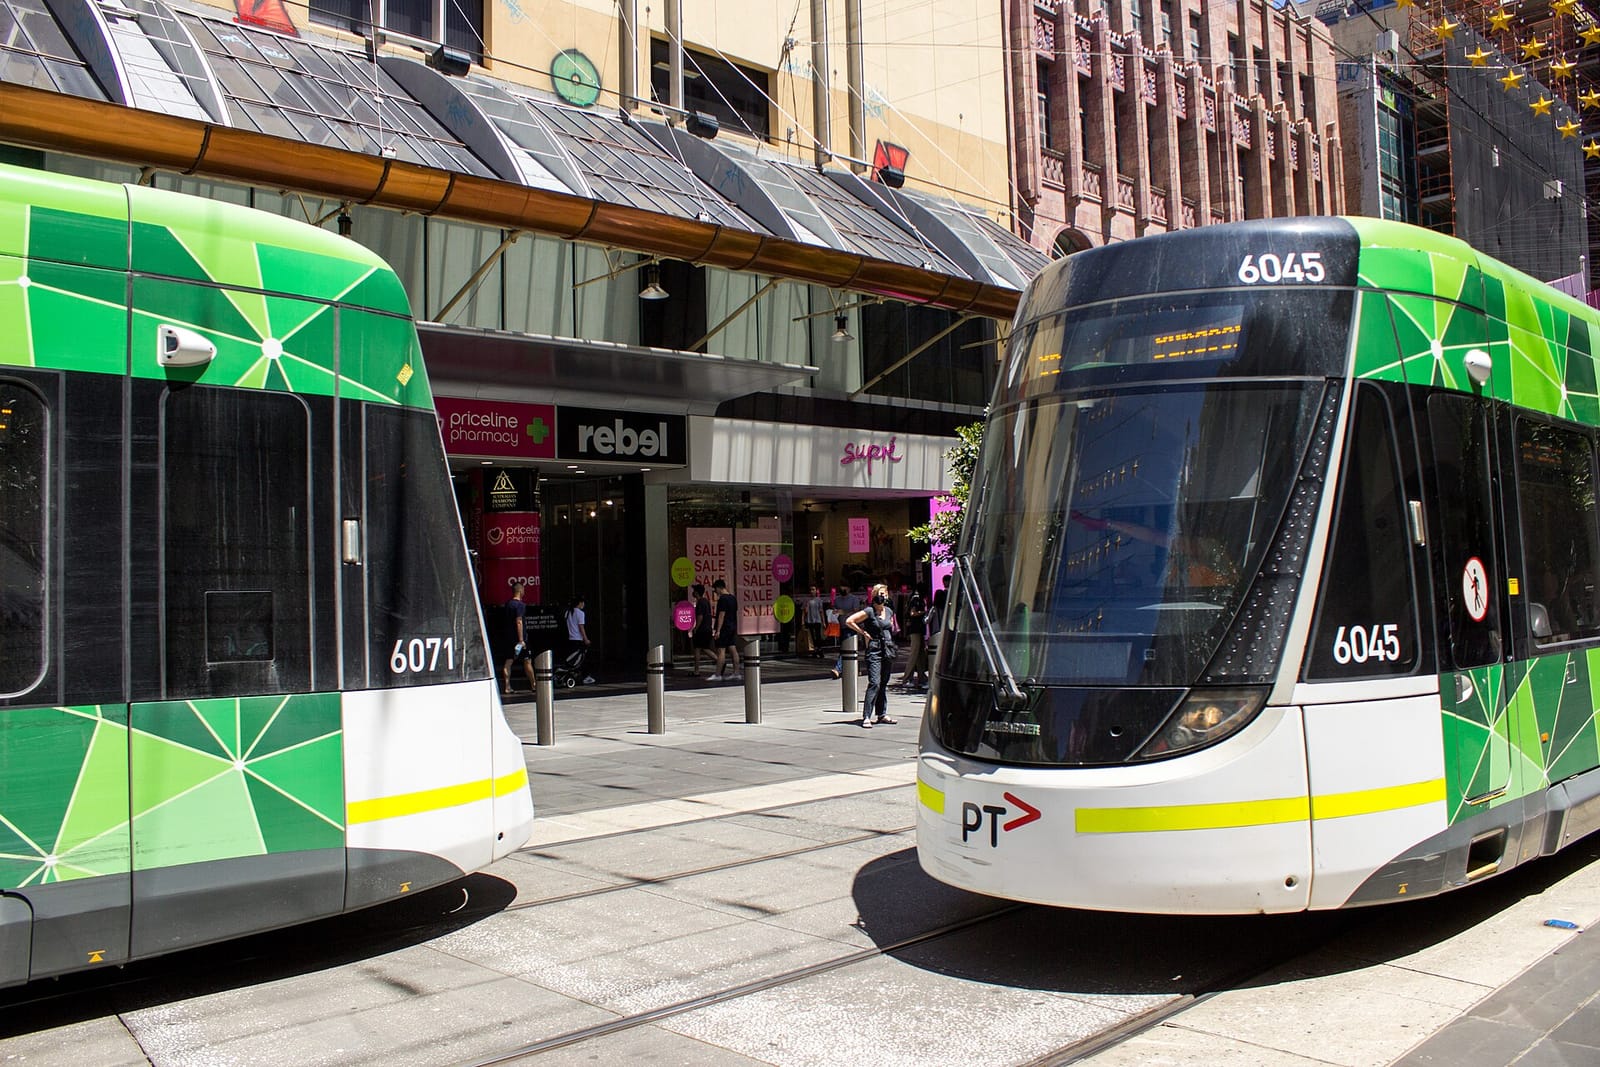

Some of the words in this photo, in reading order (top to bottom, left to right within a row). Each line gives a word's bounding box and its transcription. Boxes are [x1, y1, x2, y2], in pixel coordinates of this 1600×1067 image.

[1238, 253, 1325, 283] 6045
[450, 411, 518, 429] priceline
[450, 427, 519, 446] pharmacy
[578, 419, 668, 457] rebel
[694, 544, 725, 557] SALE
[742, 545, 772, 557] SALE
[694, 559, 725, 572] SALE
[743, 560, 773, 572] SALE
[743, 575, 772, 587] SALE
[743, 589, 773, 602] SALE
[743, 604, 774, 617] SALE
[679, 615, 692, 623] $25
[1333, 624, 1400, 664] 6045
[390, 637, 454, 673] 6071
